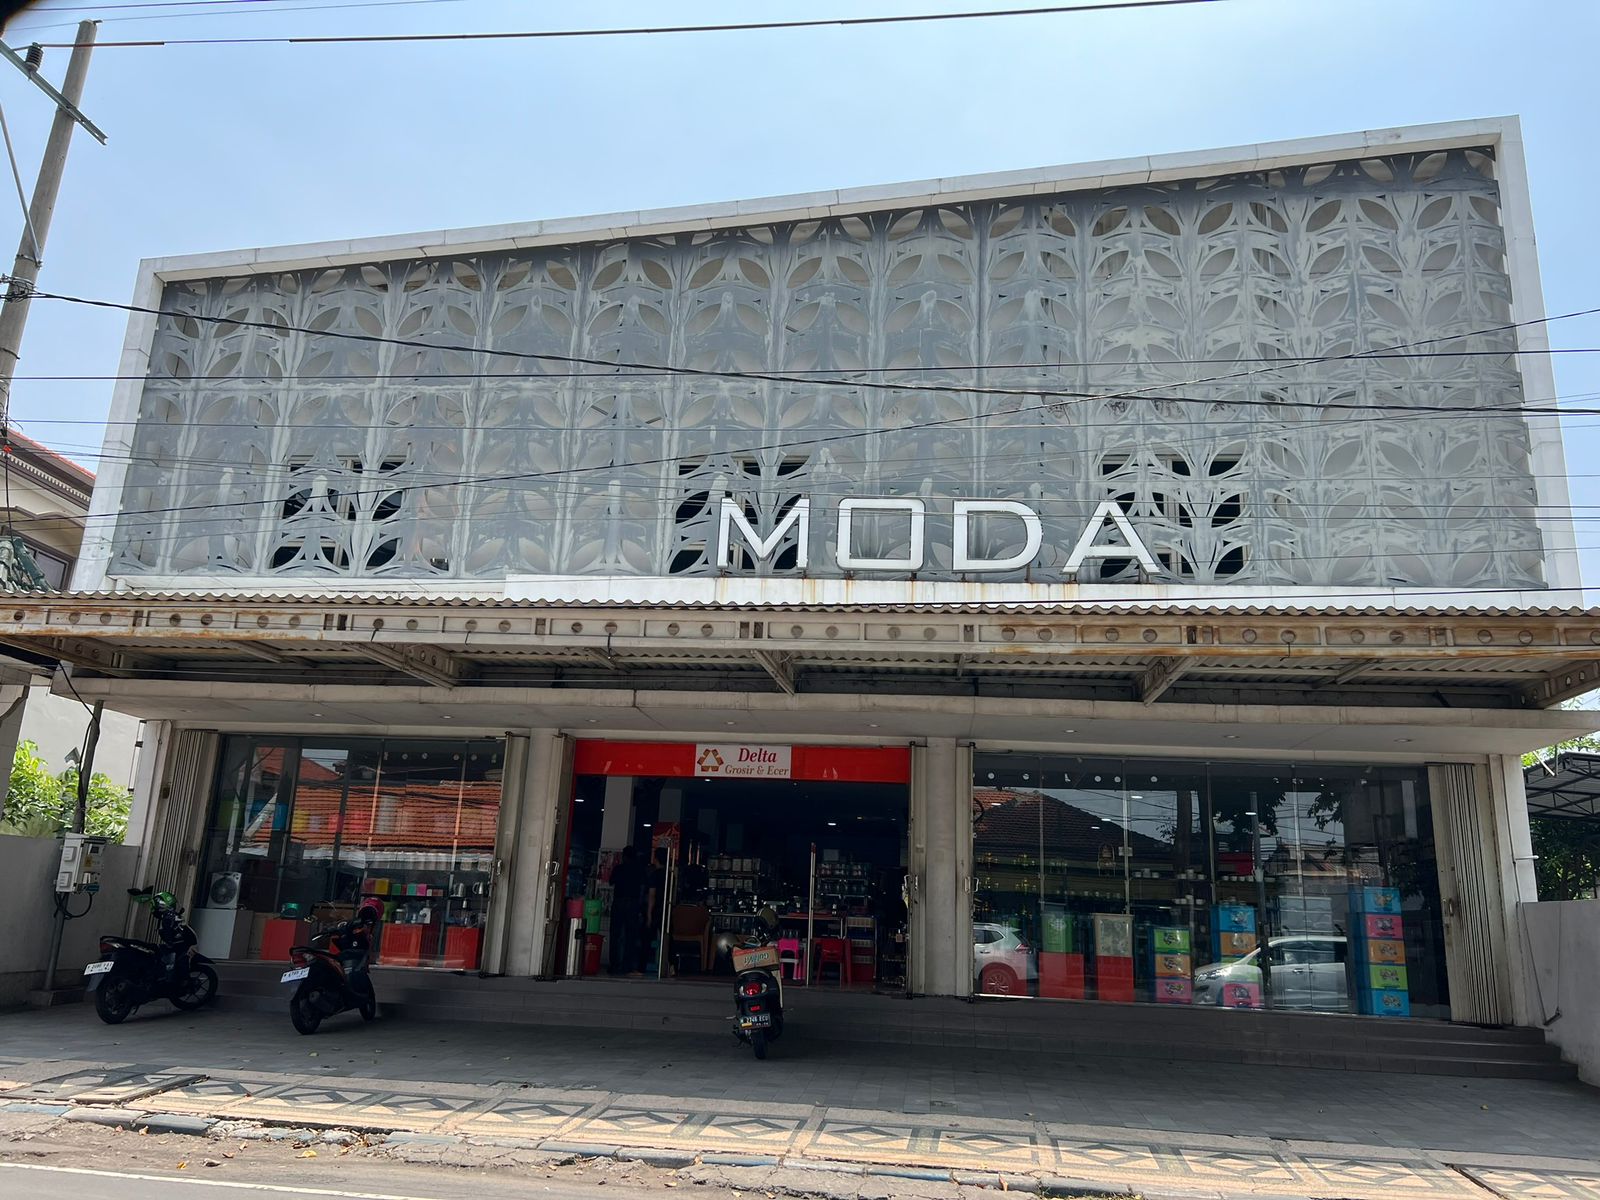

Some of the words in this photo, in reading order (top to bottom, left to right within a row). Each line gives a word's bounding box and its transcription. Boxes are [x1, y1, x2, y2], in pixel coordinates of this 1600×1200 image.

[717, 497, 1161, 575] MODA
[738, 747, 777, 763] Delta
[725, 764, 754, 775] Grosir
[757, 765, 764, 775] &
[767, 765, 789, 776] Ecer
